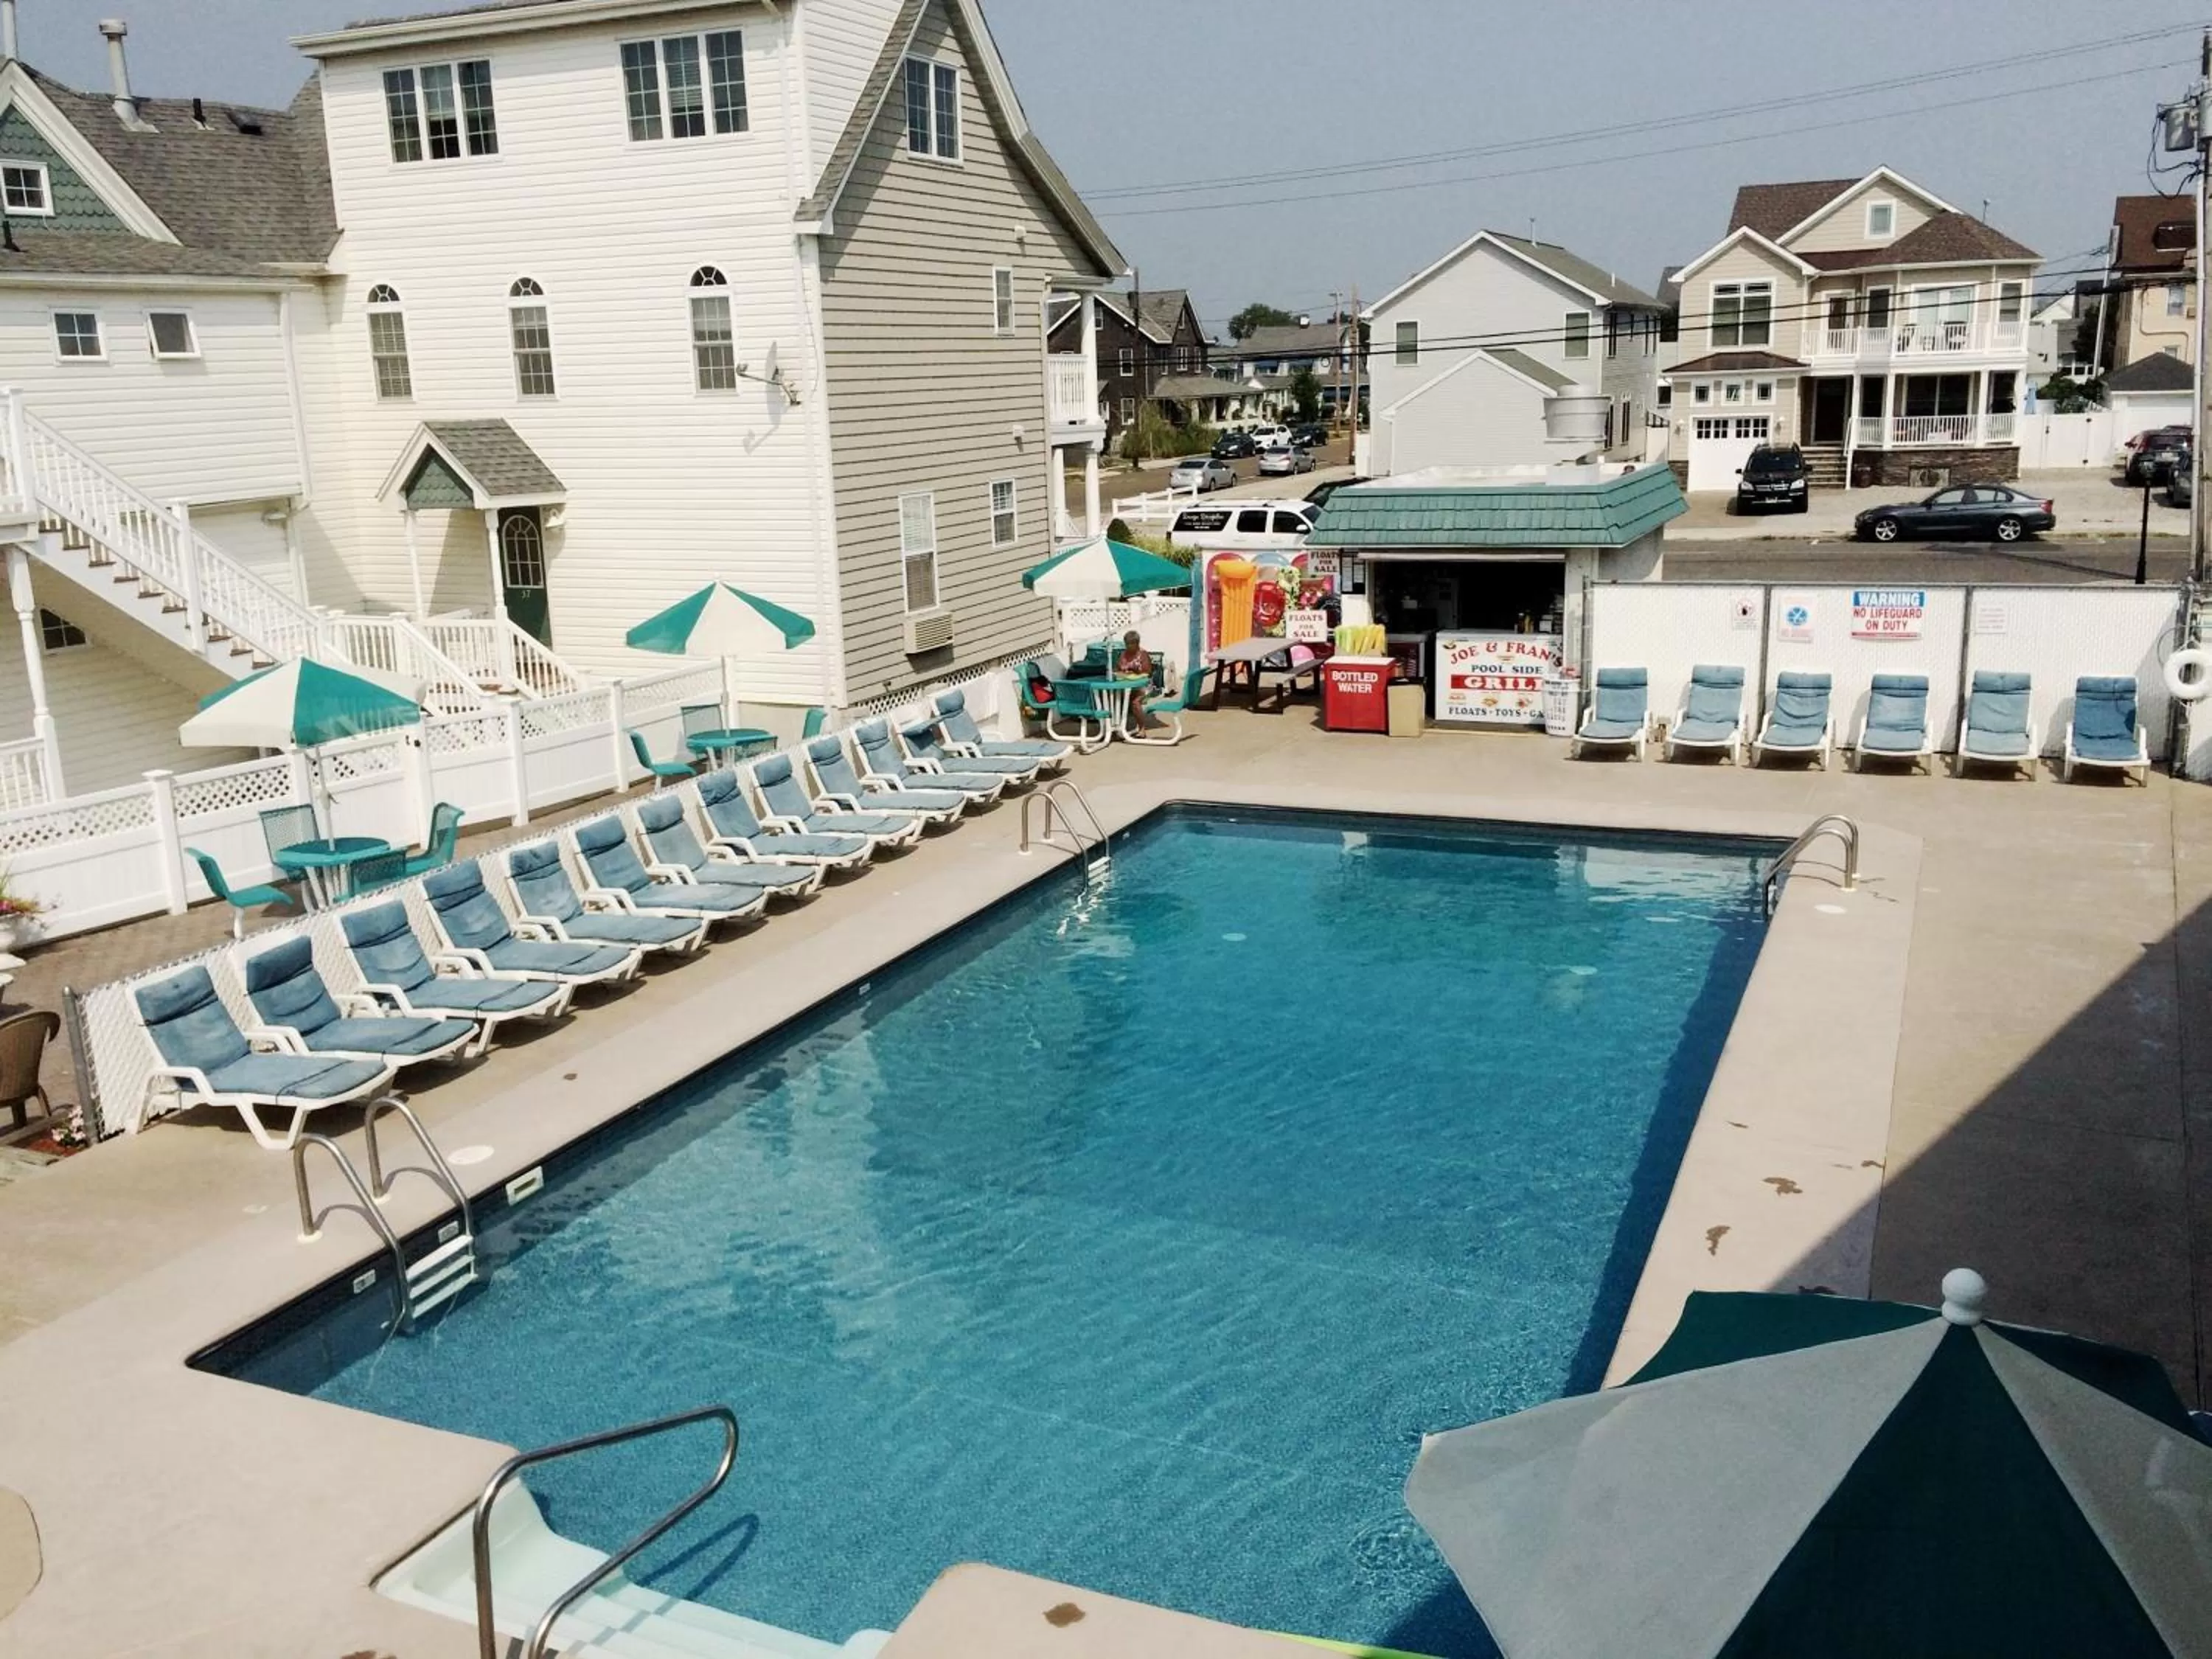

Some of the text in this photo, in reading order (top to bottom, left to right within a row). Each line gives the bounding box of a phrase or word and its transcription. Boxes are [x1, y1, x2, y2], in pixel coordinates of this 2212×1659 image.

[1859, 591, 1920, 607] WARNING
[1853, 607, 1922, 619] NO LIFEGUARD
[1865, 619, 1908, 630] ON DUTY
[1450, 641, 1562, 667] JOE & FRAN'S
[1471, 664, 1544, 675] POOL SIDE
[1332, 670, 1378, 683] BOTTLED
[1338, 681, 1373, 693] WATER
[1448, 706, 1545, 719] FLOATS TOYS GA
